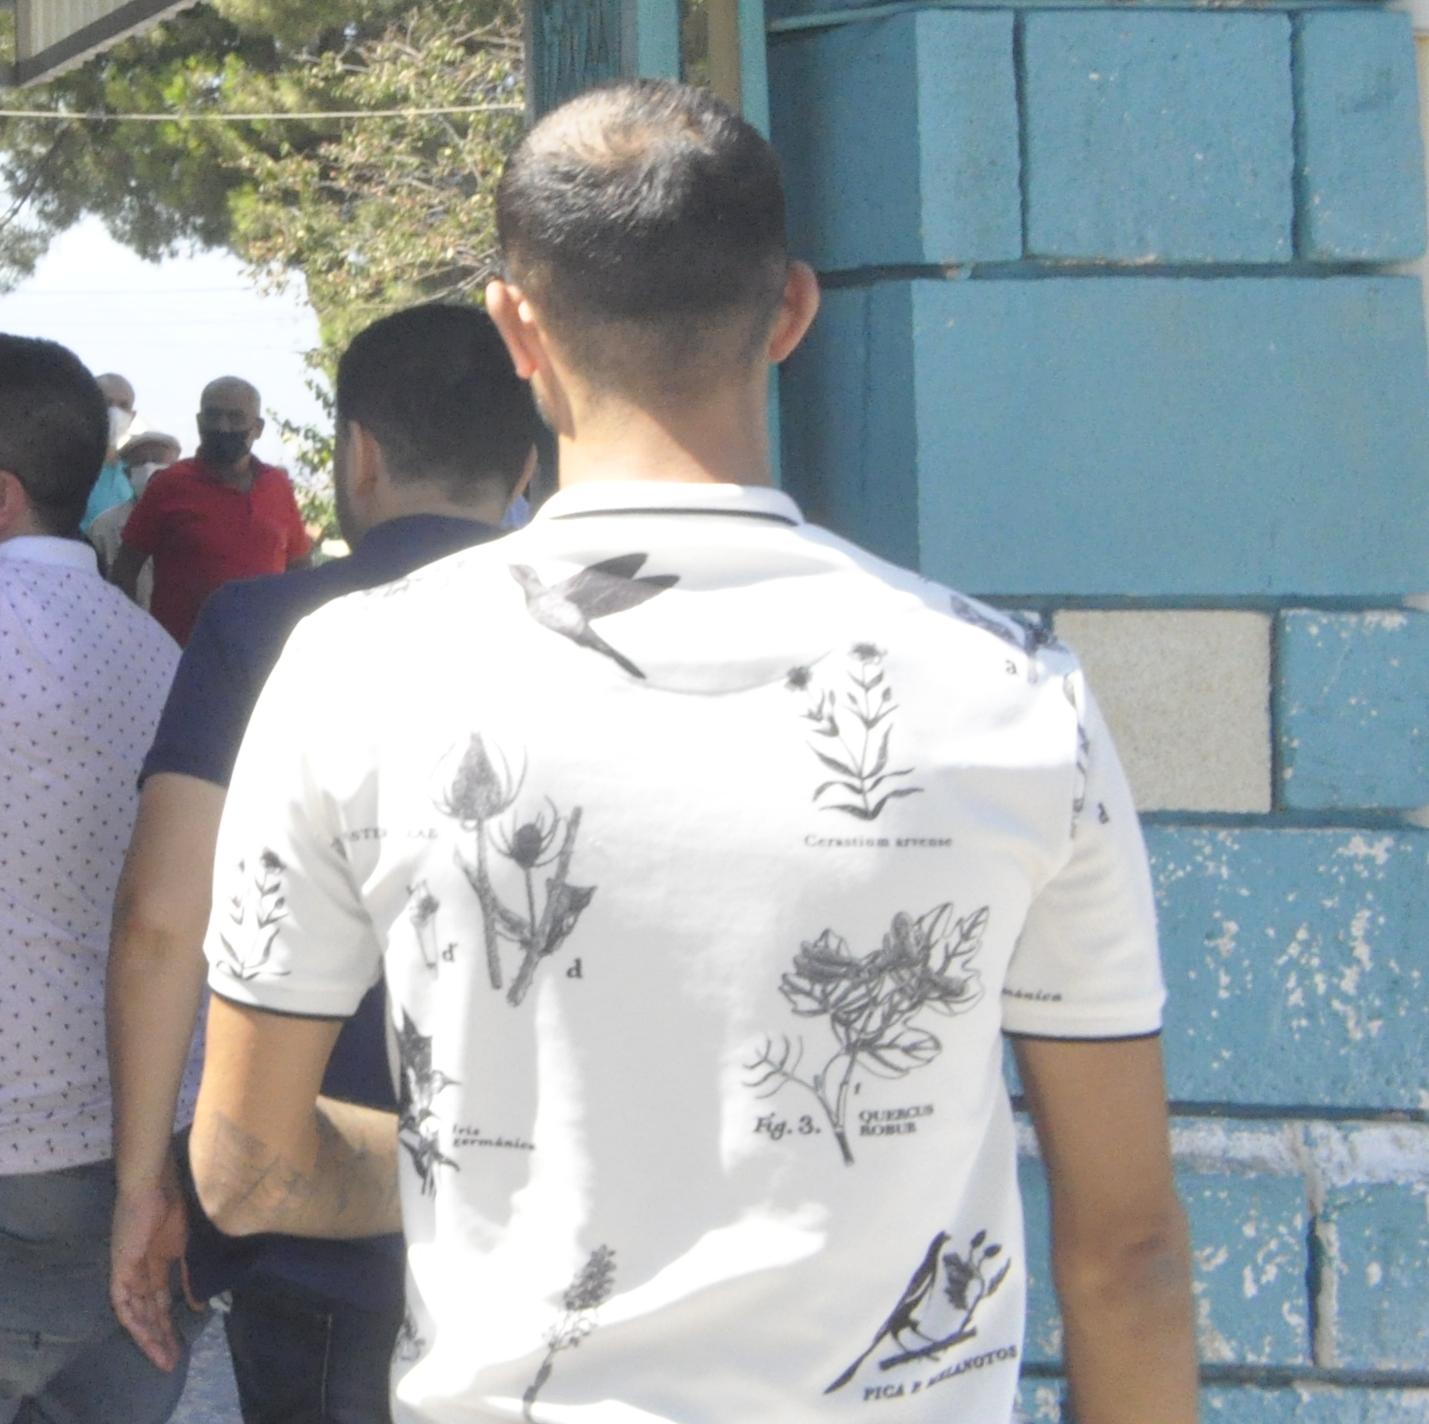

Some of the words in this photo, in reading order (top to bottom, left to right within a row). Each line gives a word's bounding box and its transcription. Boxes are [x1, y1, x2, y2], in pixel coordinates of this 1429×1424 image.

[566, 958, 582, 978] d
[754, 1113, 793, 1140] Fig.
[798, 1114, 821, 1135] 3.
